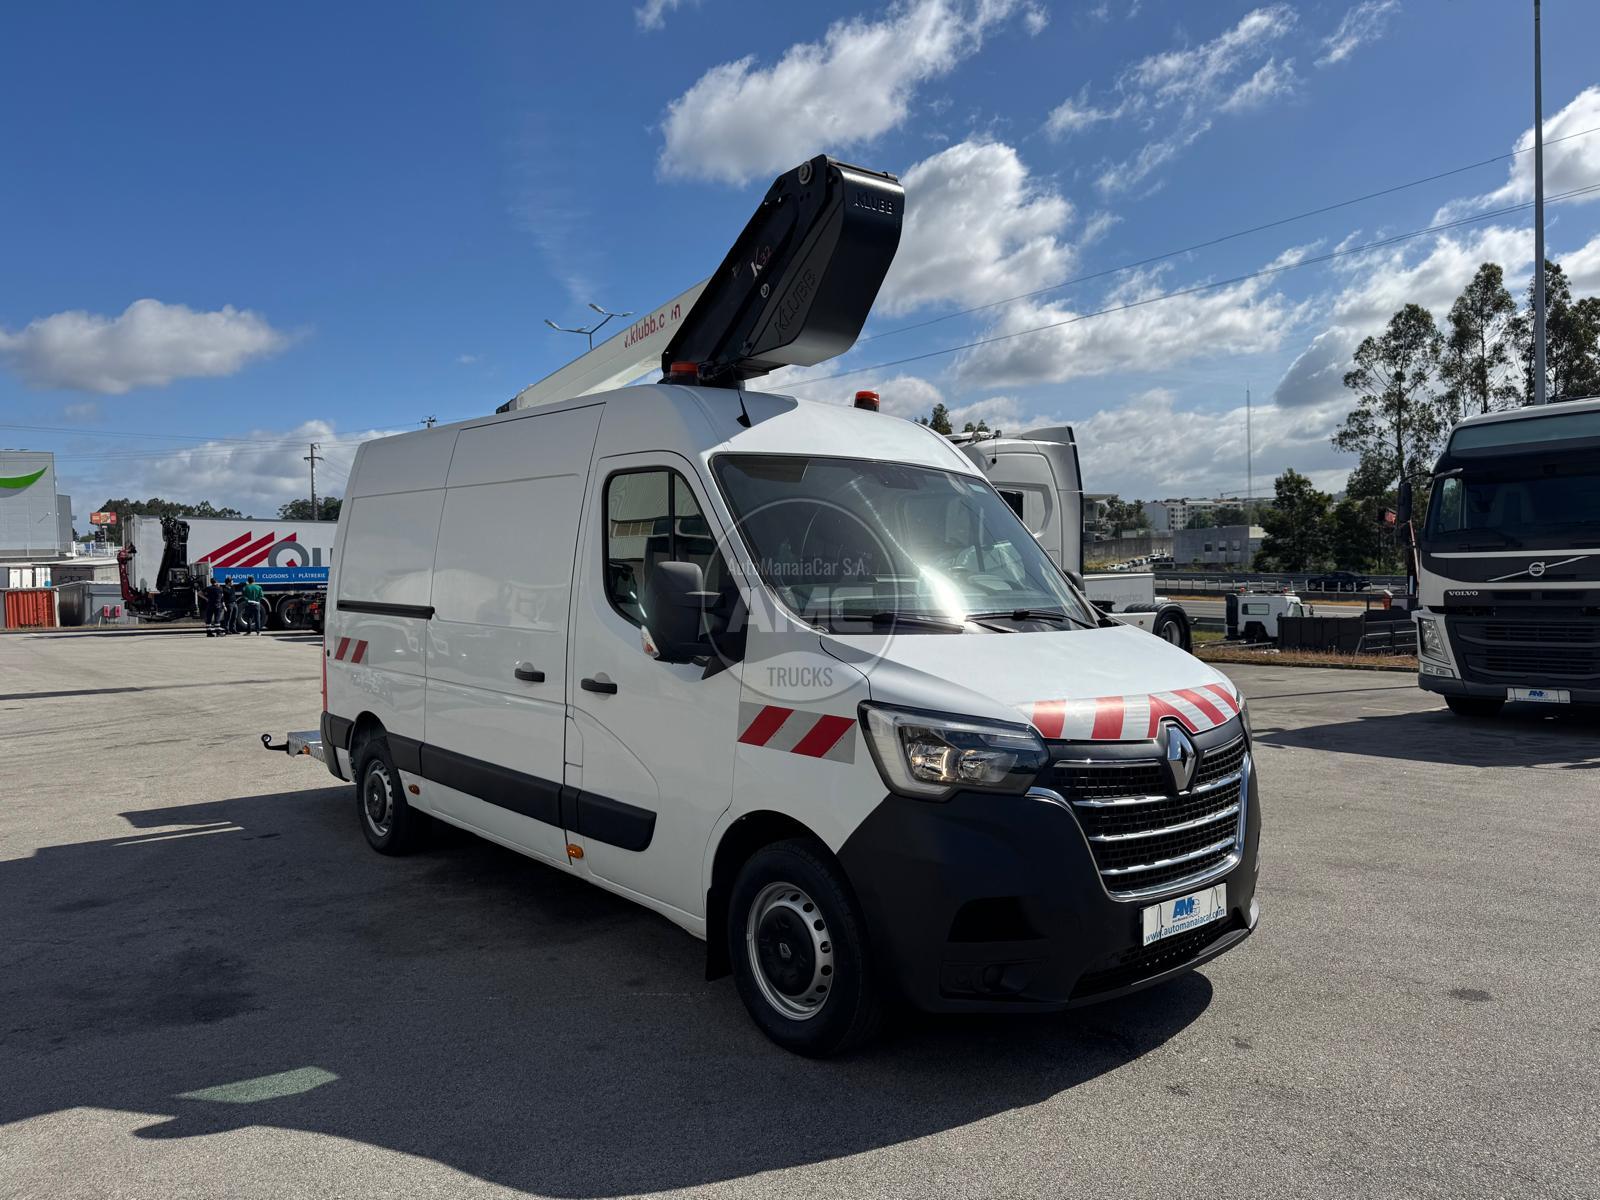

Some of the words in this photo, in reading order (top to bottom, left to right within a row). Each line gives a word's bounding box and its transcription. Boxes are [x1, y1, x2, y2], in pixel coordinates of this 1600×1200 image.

[854, 192, 893, 215] KLUBB
[774, 268, 816, 343] KLUBB
[1145, 908, 1226, 943] www.automanaiacar.com
